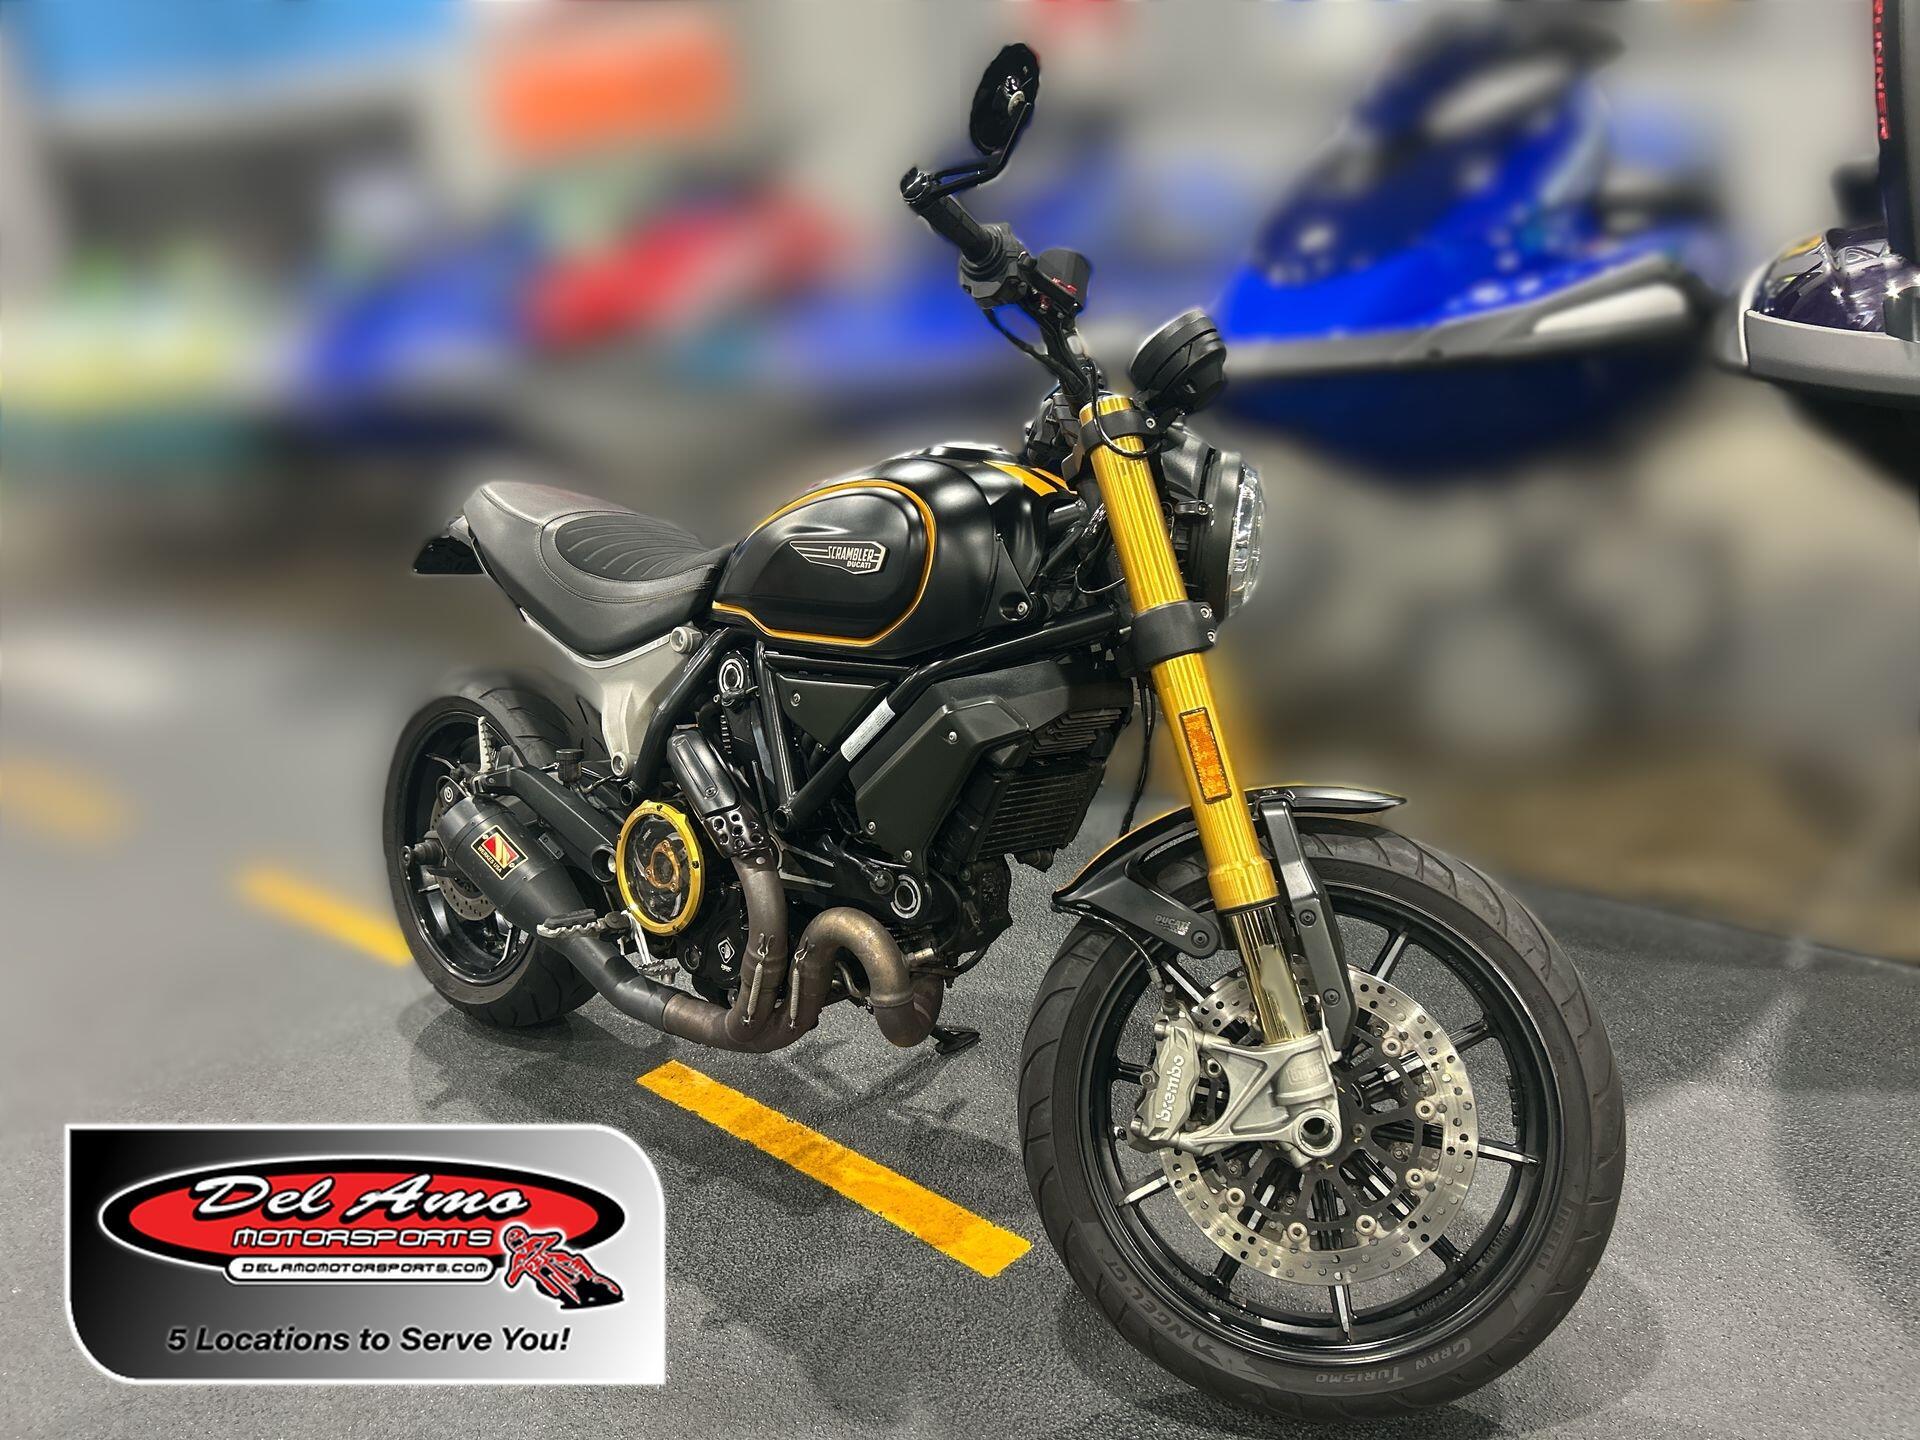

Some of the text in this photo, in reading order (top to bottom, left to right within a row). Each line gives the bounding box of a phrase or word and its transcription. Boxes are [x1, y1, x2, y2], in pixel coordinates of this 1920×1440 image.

[827, 546, 875, 561] SCRAMBLER
[846, 560, 871, 569] DUCATI
[1156, 1055, 1185, 1122] brembo
[1104, 1260, 1127, 1282] GT
[1132, 1286, 1223, 1367] ANGEL
[1316, 1337, 1471, 1384] GRAN TURISMO
